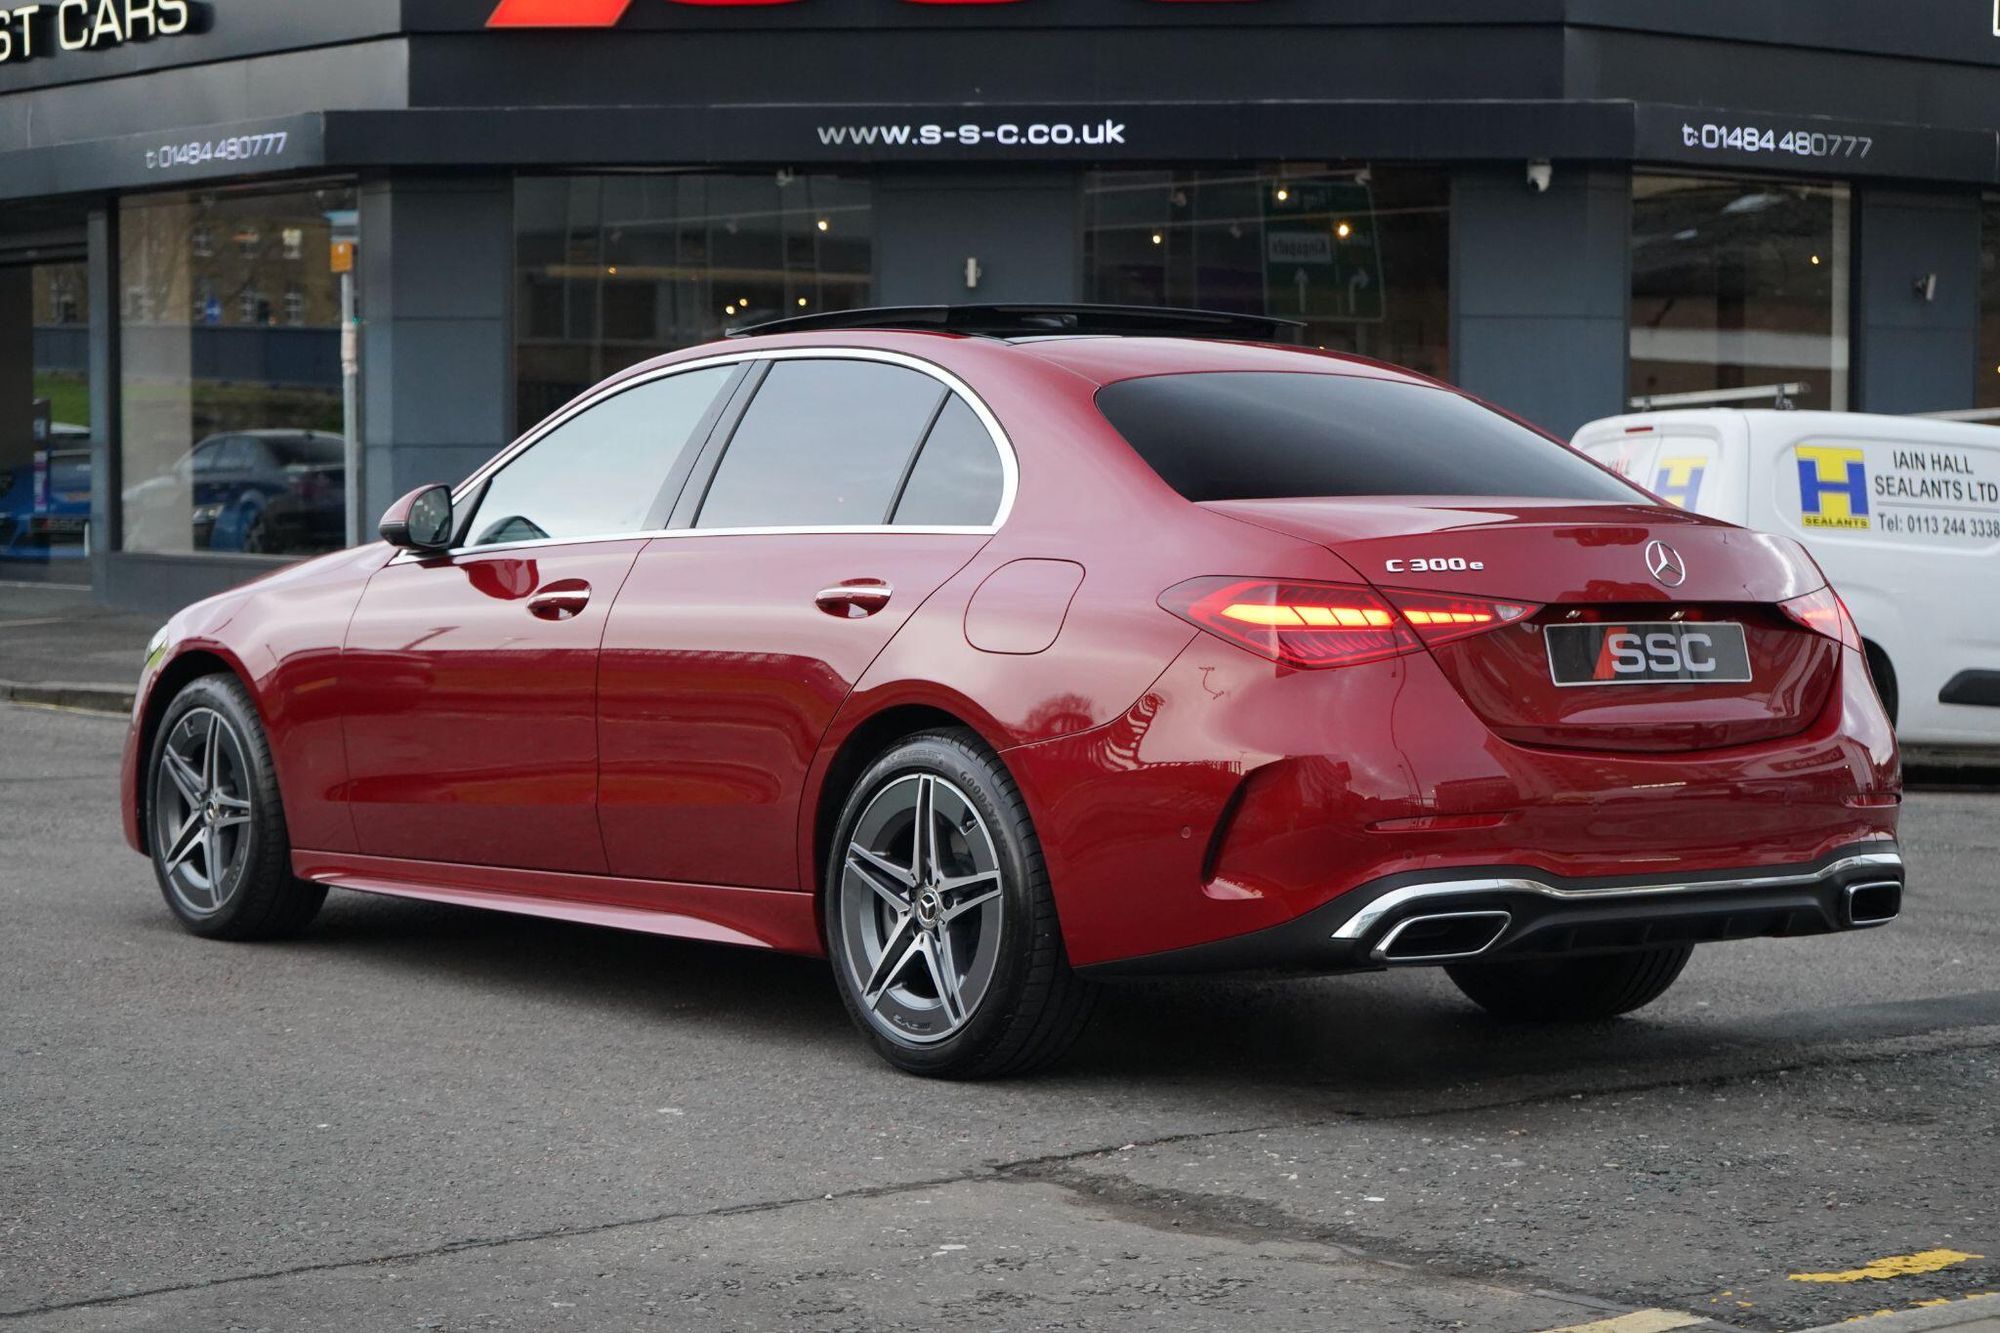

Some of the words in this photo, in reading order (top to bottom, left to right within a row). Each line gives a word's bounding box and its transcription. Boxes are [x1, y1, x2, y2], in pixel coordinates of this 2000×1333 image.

[58, 0, 188, 51] CARS
[817, 119, 1125, 145] www.s-s-c.co.uk
[1779, 131, 1872, 159] 480777
[214, 131, 287, 160] 480777
[1893, 450, 1925, 470] IAIN
[1931, 454, 1974, 475] HALL
[1874, 475, 1963, 500] SEALANTS
[1968, 482, 1998, 502] LTD
[1805, 517, 1867, 528] SEALANTS
[1878, 512, 1903, 532] Tel:
[1908, 514, 1938, 535] 0113
[1943, 517, 1966, 536] 244
[1386, 559, 1404, 572] C
[1409, 558, 1467, 572] 300
[1469, 562, 1484, 570] e
[1608, 633, 1717, 674] SSC
